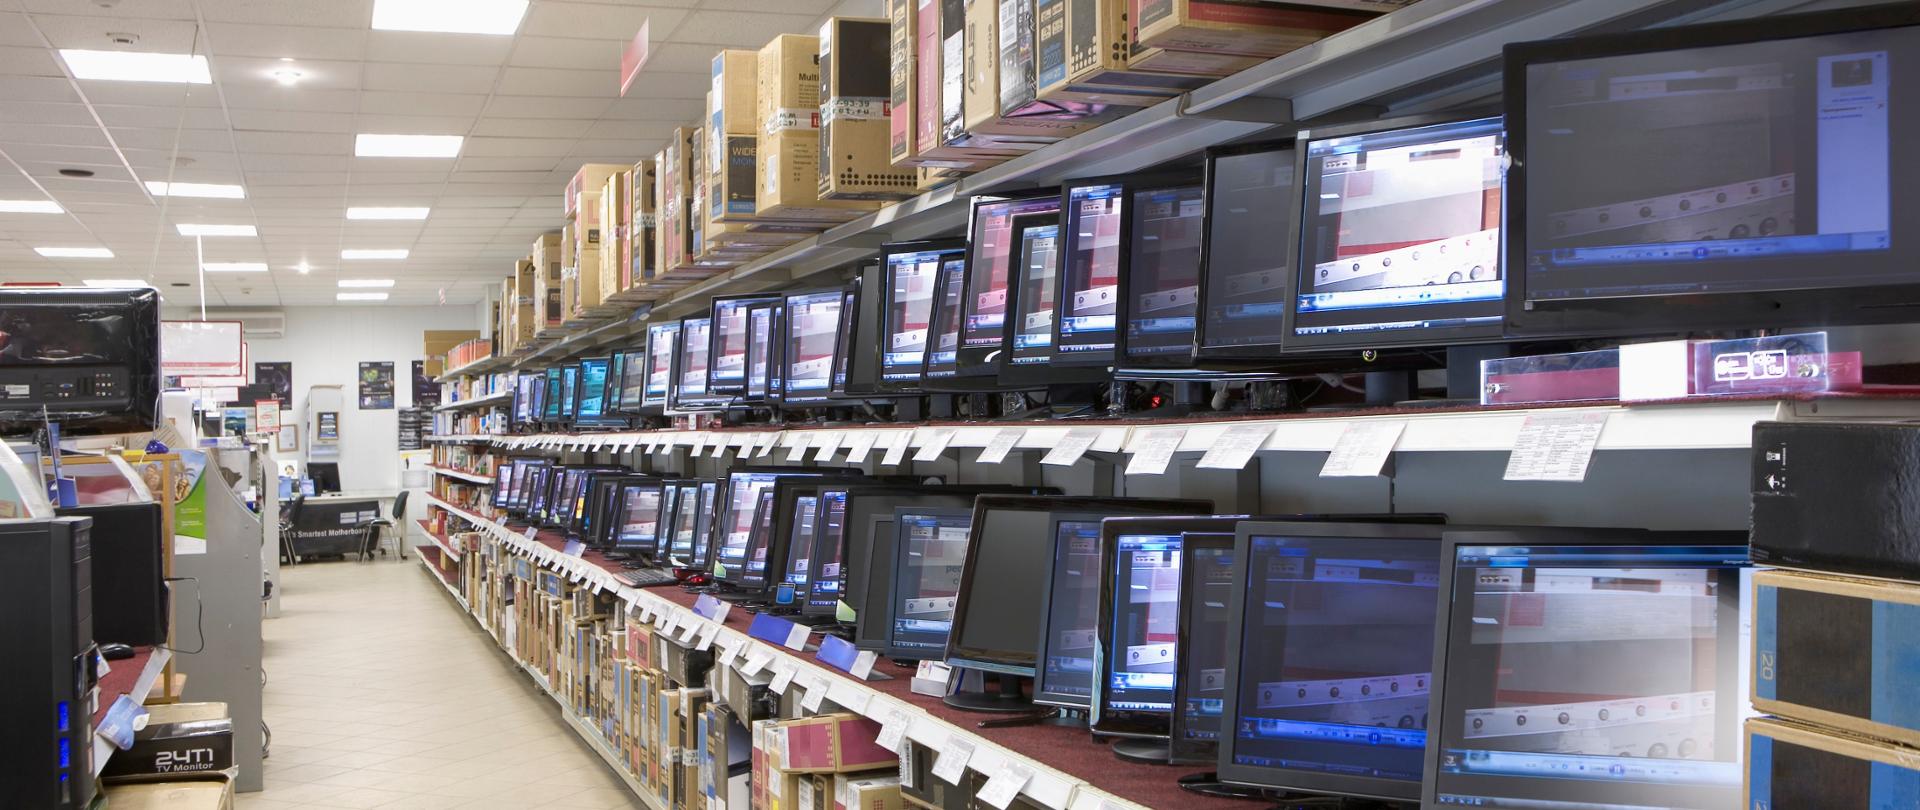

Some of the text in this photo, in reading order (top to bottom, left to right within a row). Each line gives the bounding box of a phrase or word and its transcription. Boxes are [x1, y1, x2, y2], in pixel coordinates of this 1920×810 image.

[967, 22, 976, 95] ASUS
[297, 530, 327, 539] Smartest
[1761, 655, 1774, 681] 20
[156, 748, 213, 765] 24T1
[156, 763, 213, 773] TV Monitor
